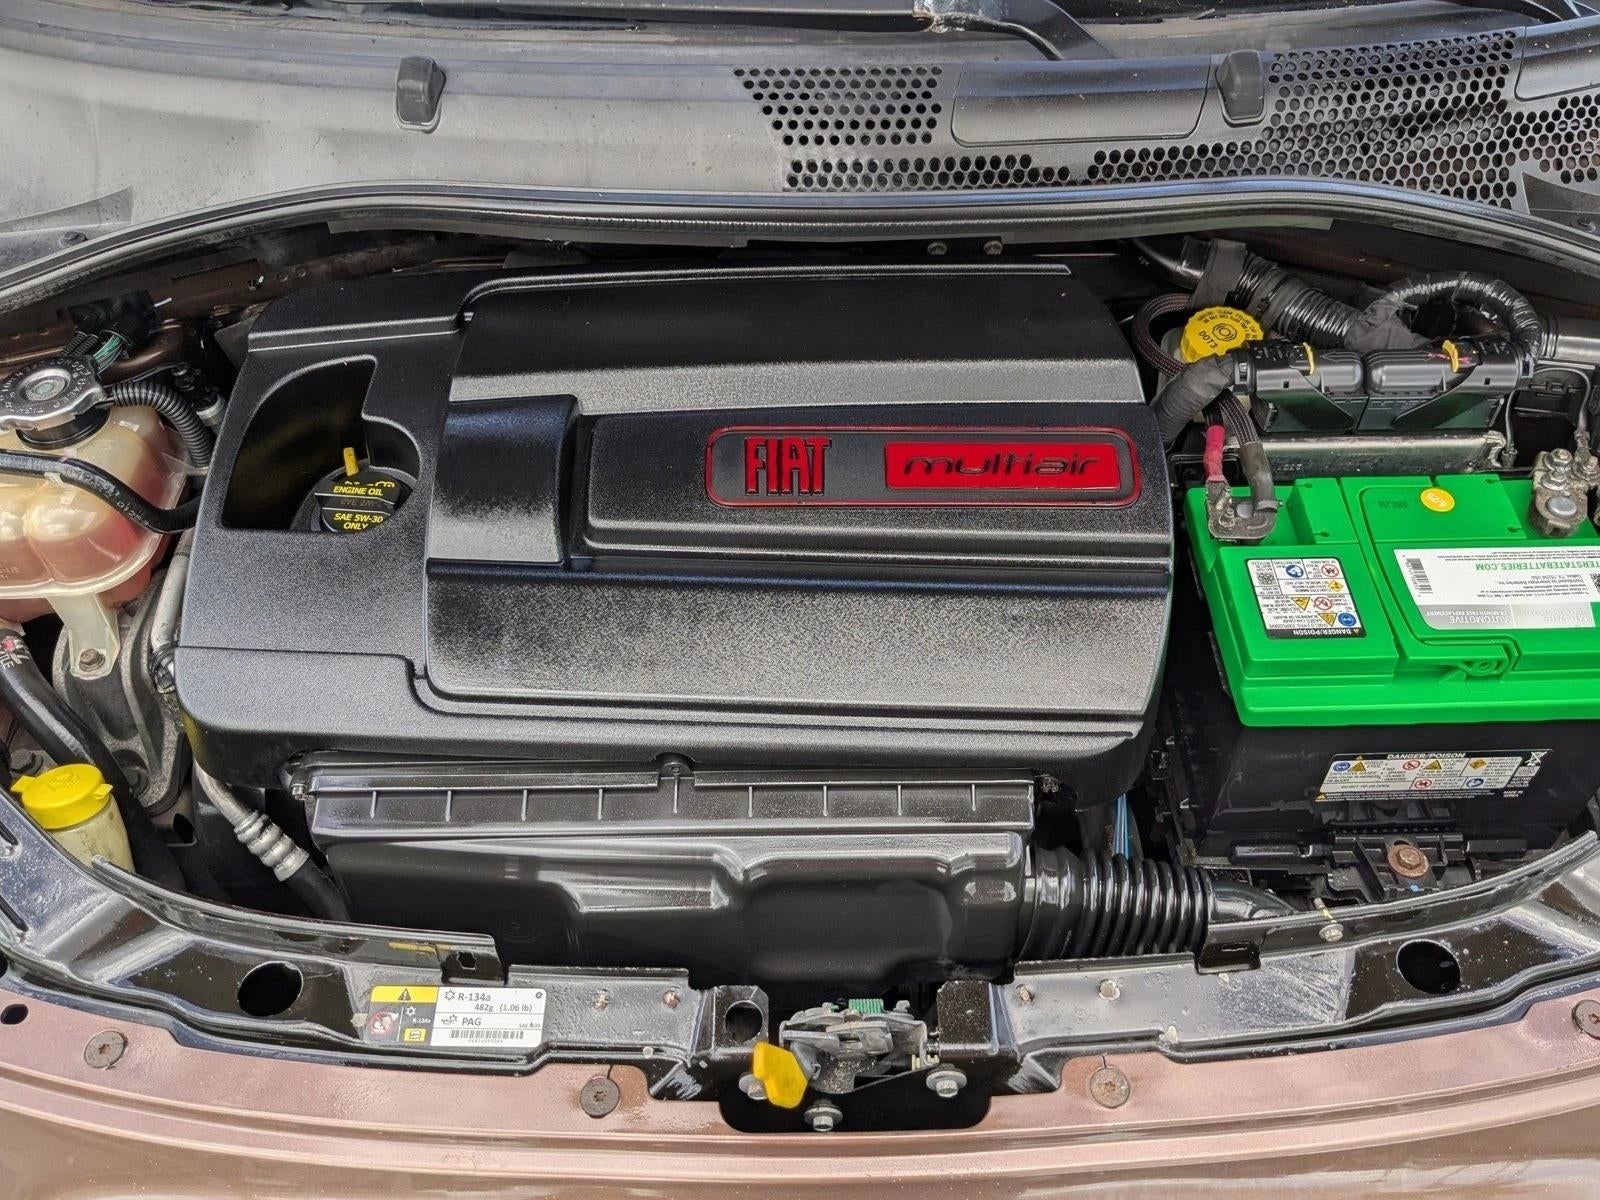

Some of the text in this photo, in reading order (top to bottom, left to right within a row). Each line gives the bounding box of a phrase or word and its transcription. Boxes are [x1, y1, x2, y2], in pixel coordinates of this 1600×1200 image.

[742, 436, 833, 496] FIAT
[902, 452, 1101, 477] multiair
[333, 486, 383, 496] ENGINE OIL
[334, 513, 384, 523] SAE 5W-30
[343, 522, 369, 530] ONLY
[1475, 560, 1600, 571] TERSTATEBATTERIES.COM
[1449, 616, 1509, 624] AUTOMOTIVE
[1387, 752, 1467, 760] DANGER/POISON
[457, 992, 491, 1002] R-134a
[474, 1003, 533, 1013] 482g (1.06 lb)
[462, 1017, 482, 1026] PAG
